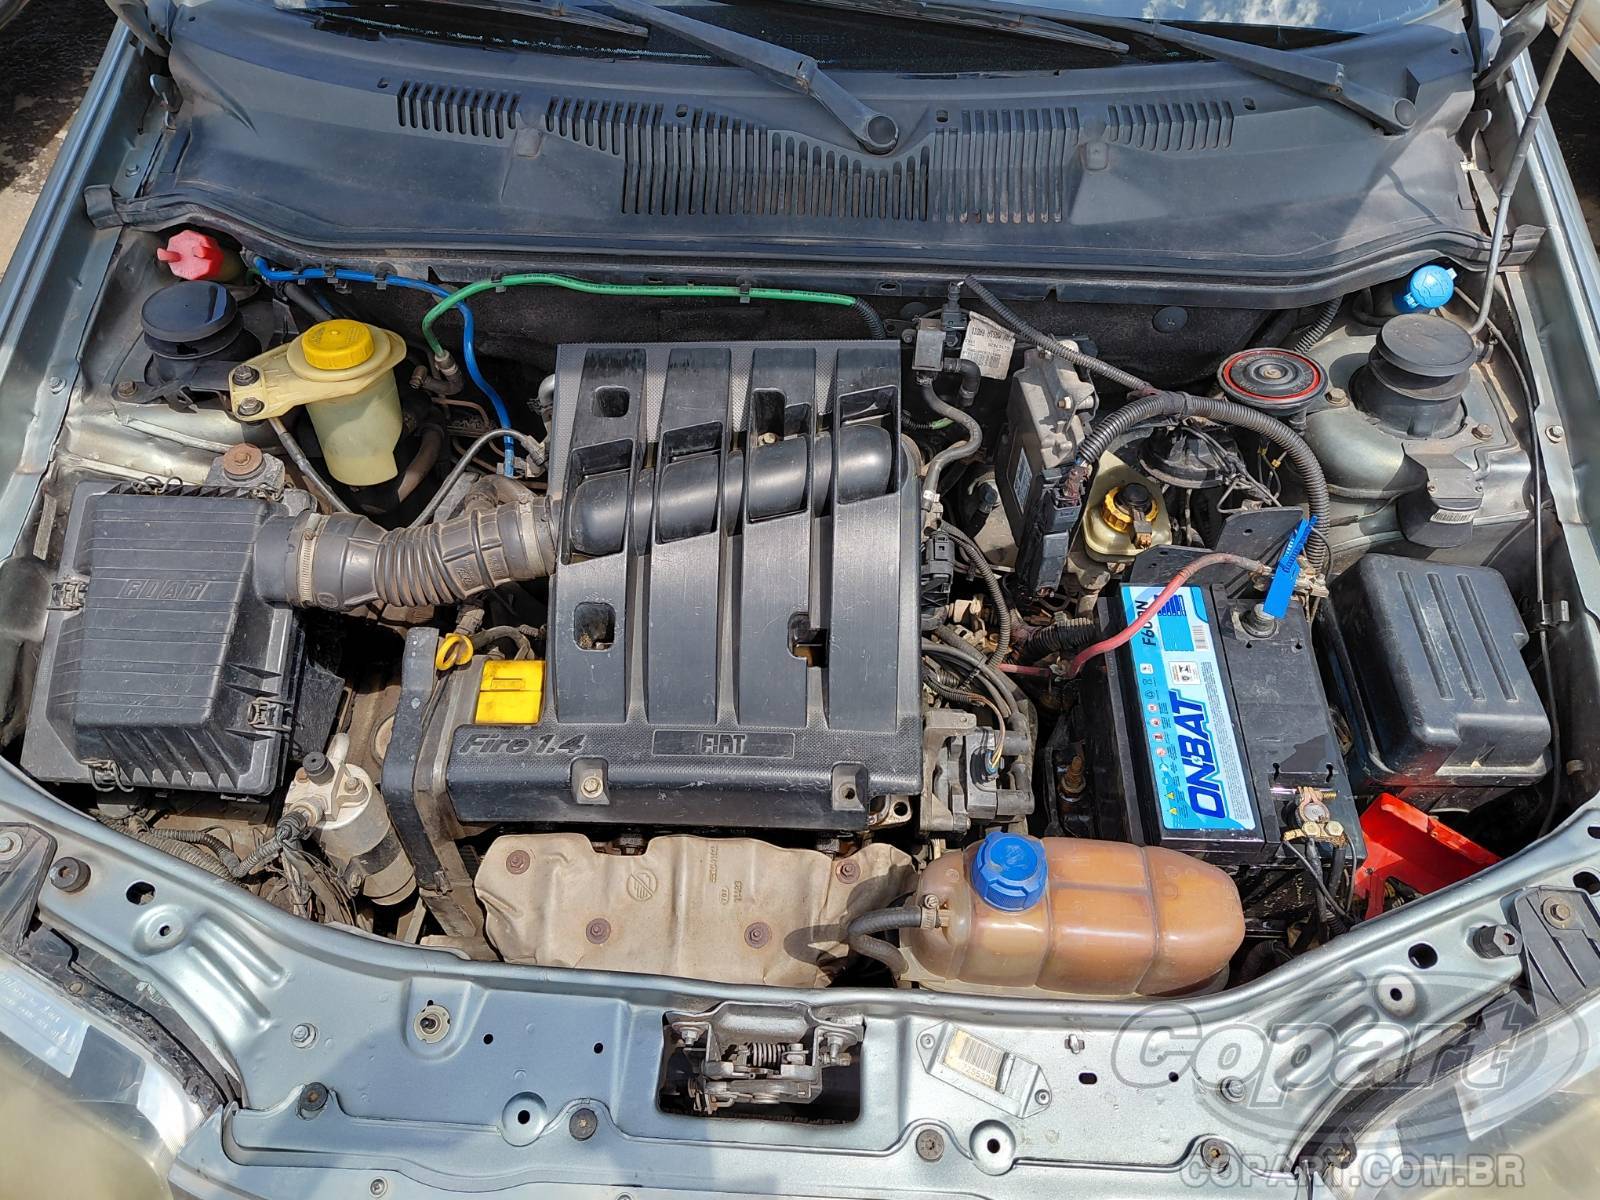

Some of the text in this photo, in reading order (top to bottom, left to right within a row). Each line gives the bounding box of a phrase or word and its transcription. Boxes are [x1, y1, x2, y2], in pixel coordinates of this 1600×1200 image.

[122, 580, 207, 599] FIAT
[1135, 600, 1157, 646] F60N
[459, 733, 587, 755] Fire 1.4
[700, 733, 747, 755] FIAT
[1169, 689, 1226, 819] ONBAT
